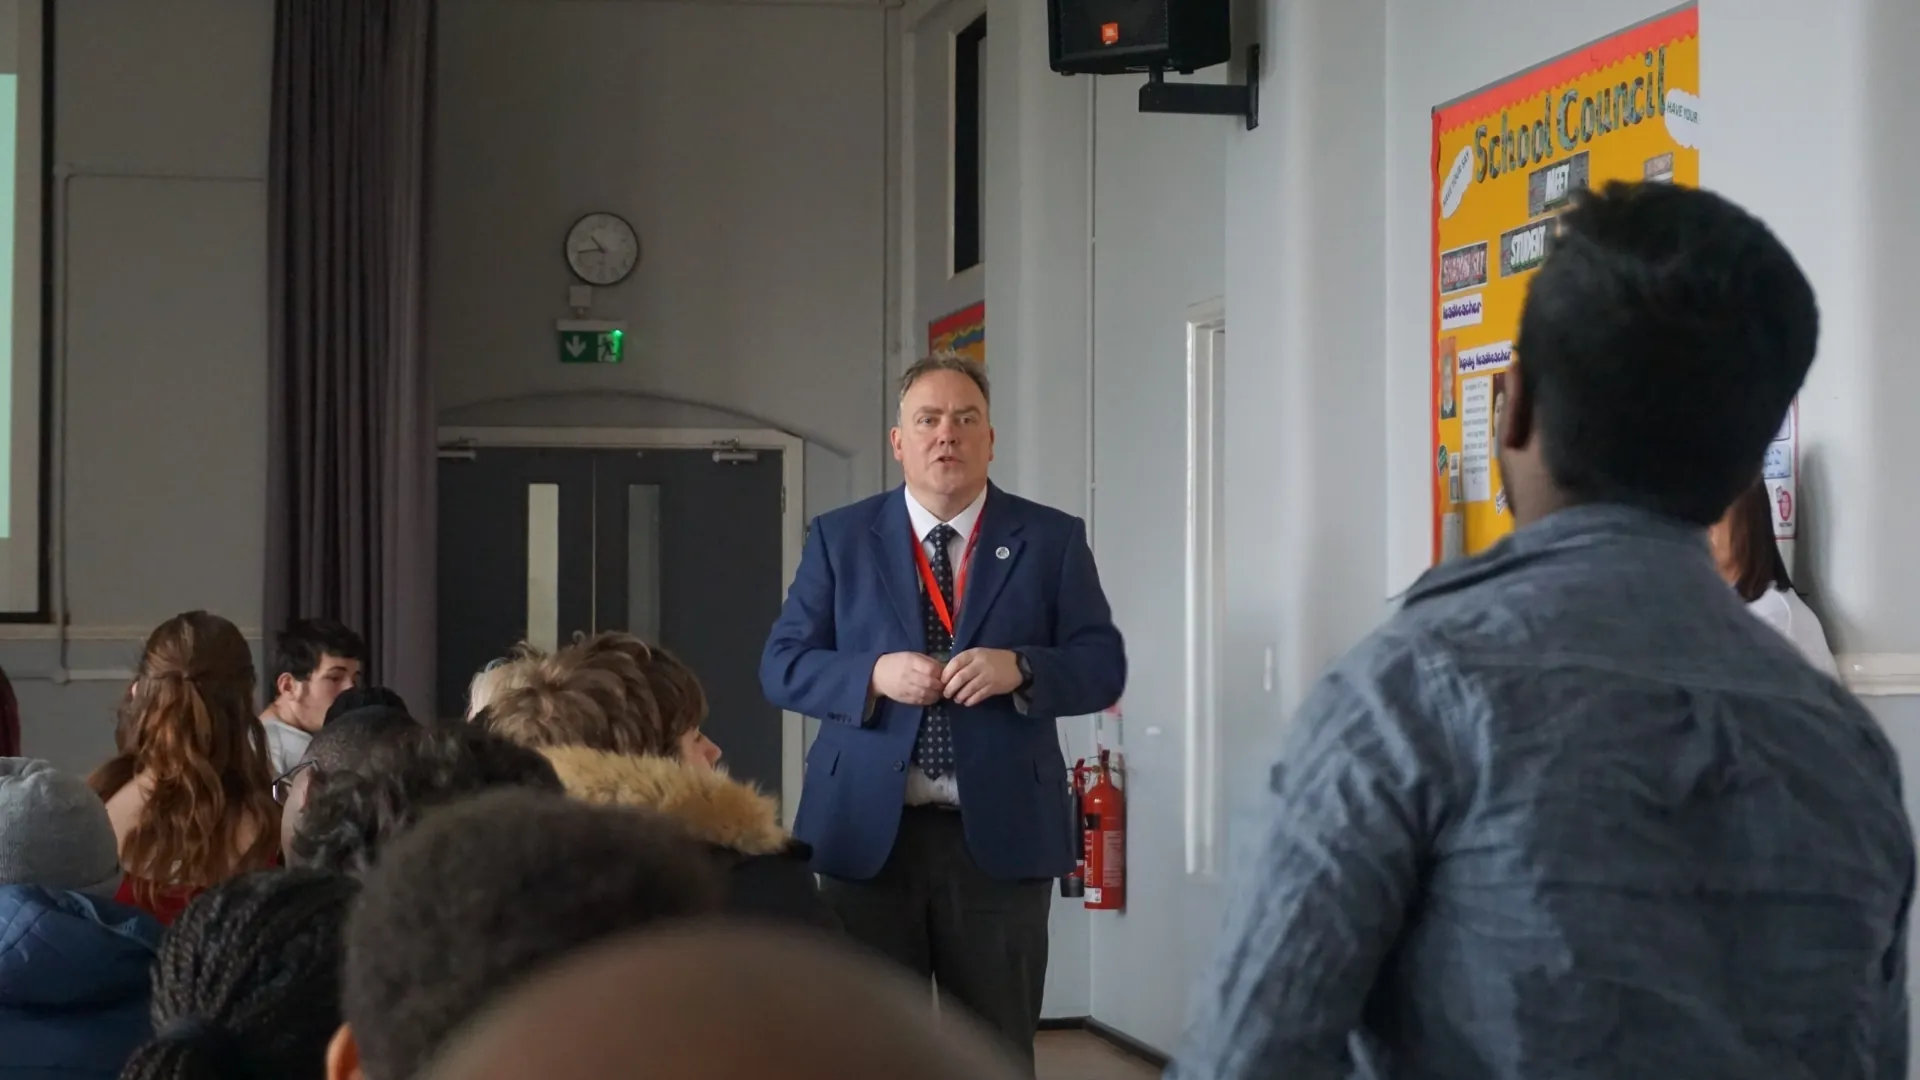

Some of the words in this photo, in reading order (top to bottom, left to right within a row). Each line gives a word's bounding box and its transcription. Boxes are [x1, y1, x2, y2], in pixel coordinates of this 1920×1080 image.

[1474, 95, 1554, 184] School
[1556, 45, 1666, 150] Council
[1667, 101, 1683, 117] HAVE
[1683, 108, 1698, 123] YOUR
[1545, 162, 1570, 202] MEET
[1510, 225, 1546, 266] STUDENT
